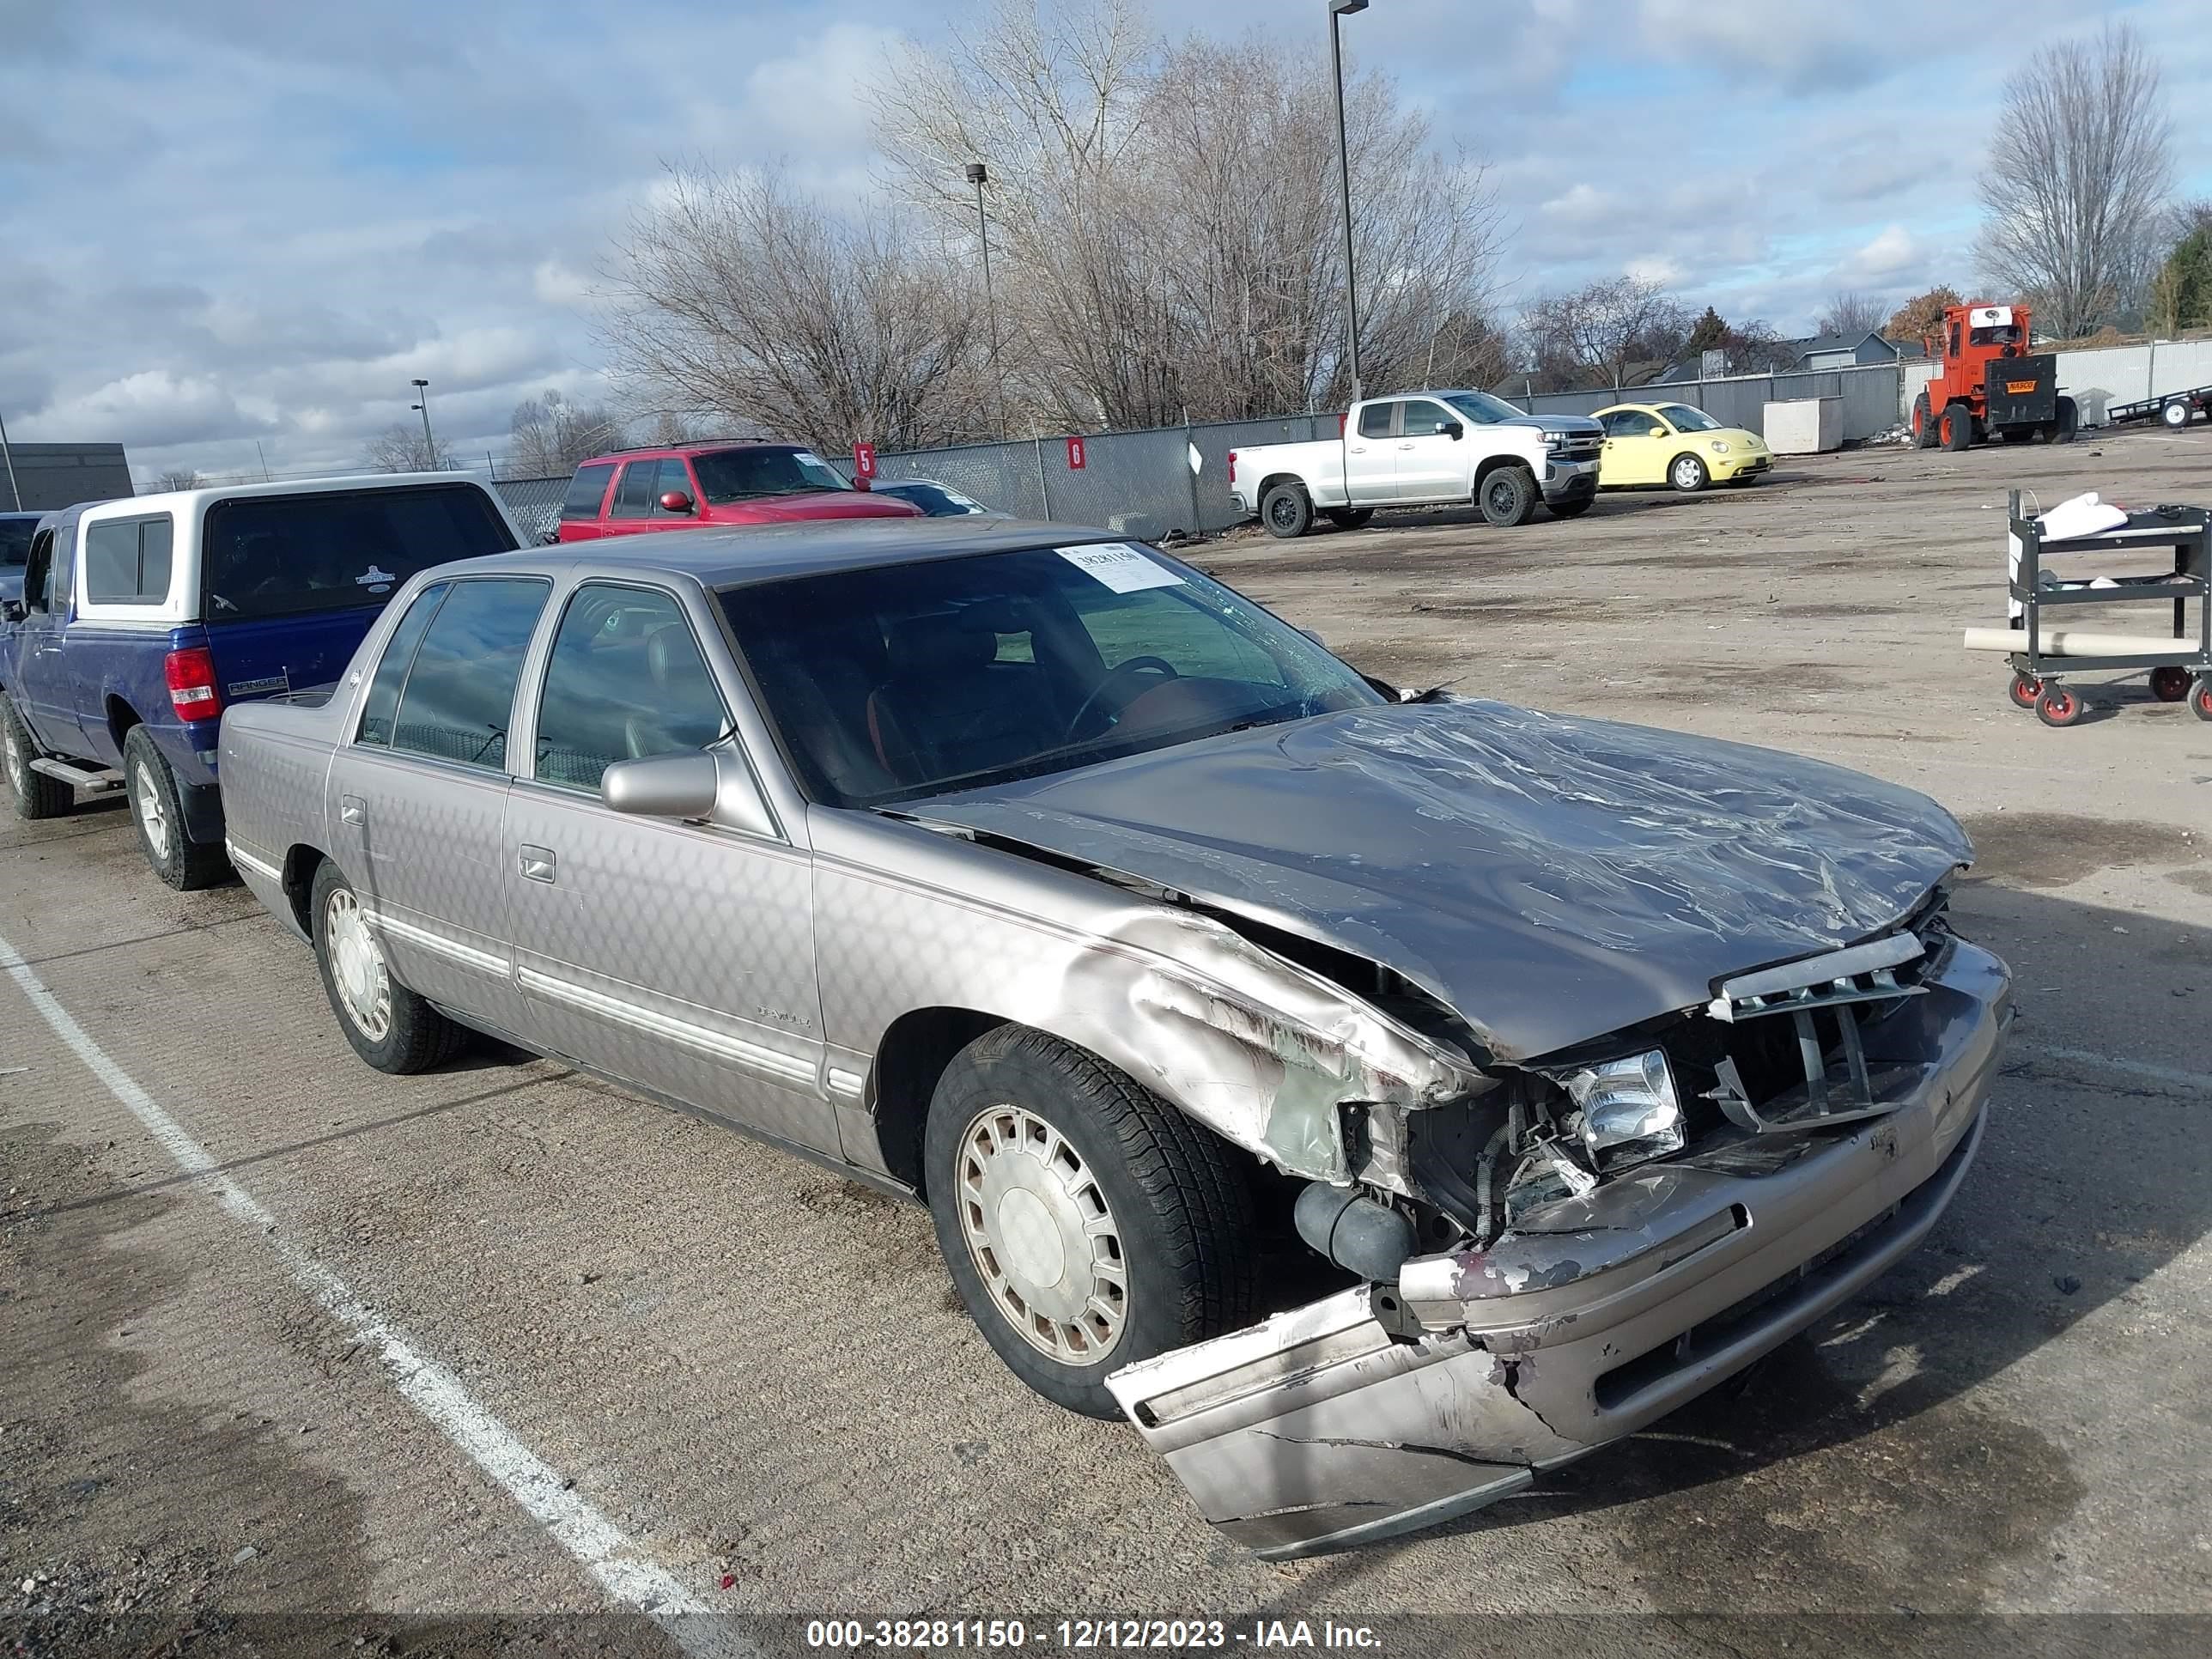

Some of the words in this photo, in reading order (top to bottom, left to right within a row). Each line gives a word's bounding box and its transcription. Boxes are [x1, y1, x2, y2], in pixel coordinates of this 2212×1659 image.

[860, 449, 871, 472] 5
[1072, 443, 1080, 465] 6
[1077, 552, 1139, 566] 38281150
[229, 677, 287, 692] RANGER
